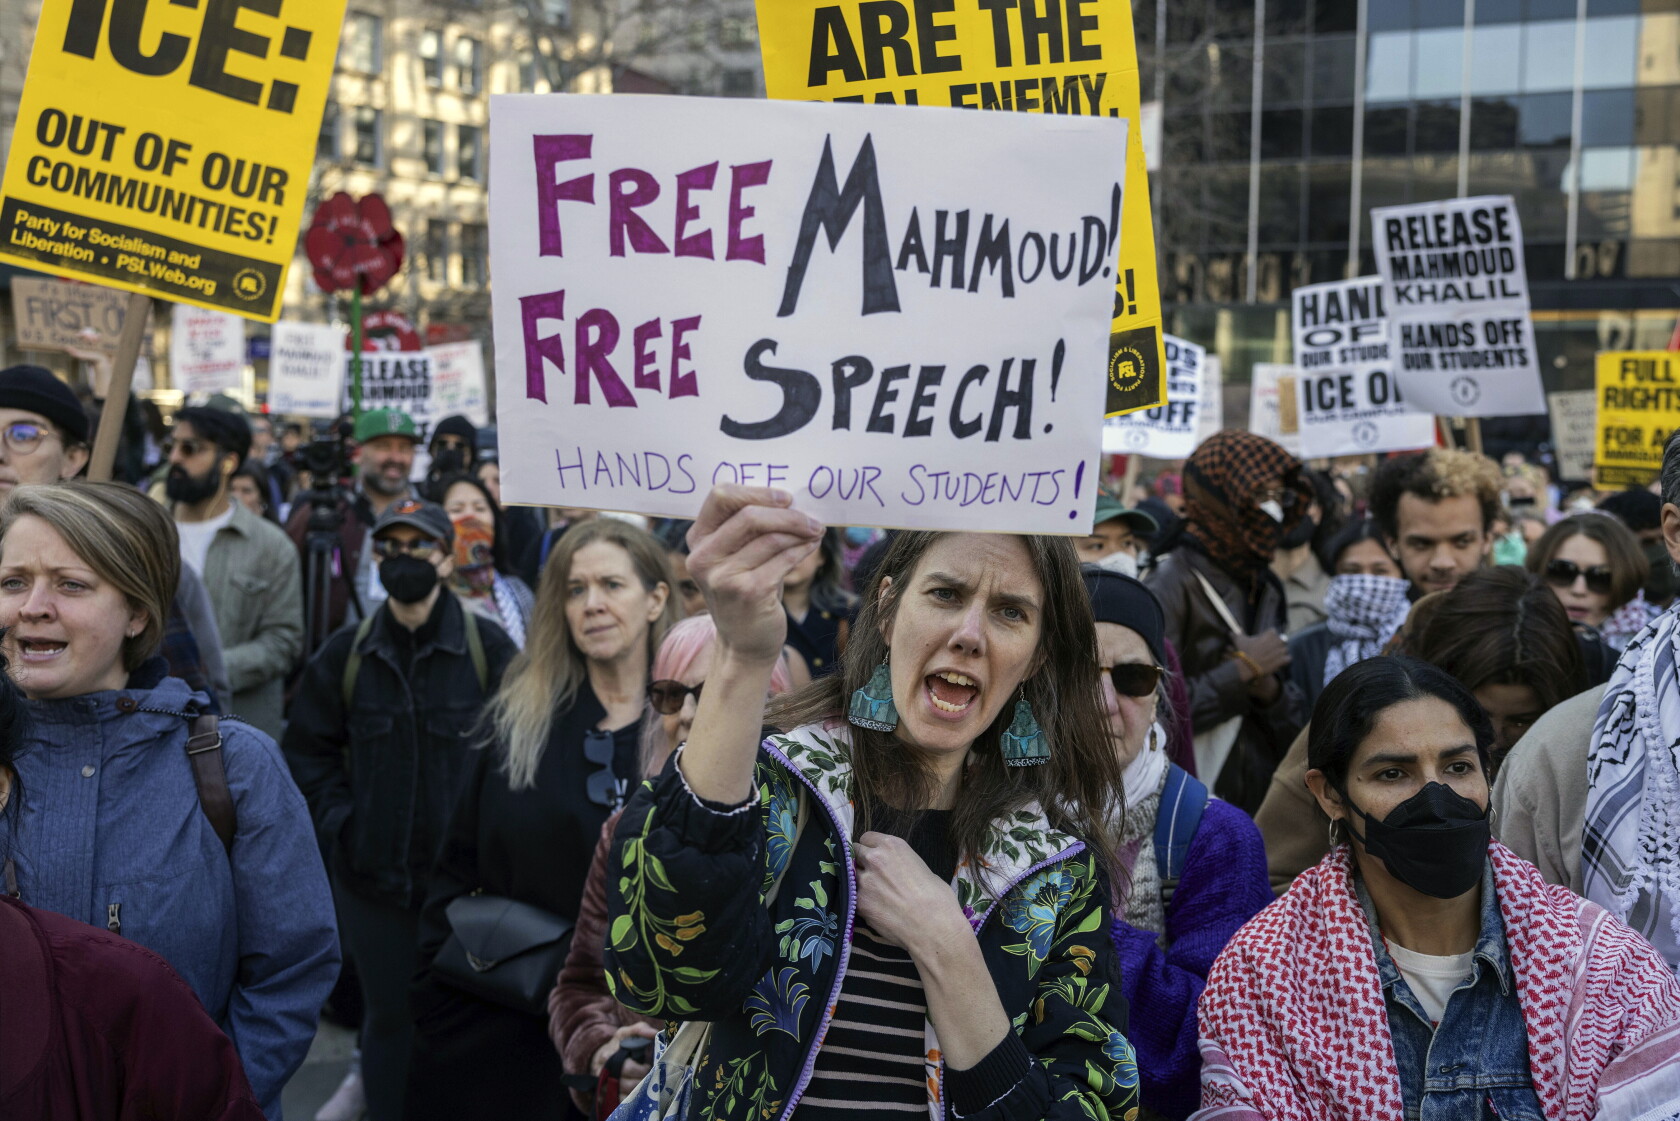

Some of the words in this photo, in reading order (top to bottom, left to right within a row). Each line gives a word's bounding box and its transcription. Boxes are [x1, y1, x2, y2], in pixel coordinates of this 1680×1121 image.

[62, 0, 313, 115] ICE:
[807, 0, 963, 88] ARE
[977, 0, 1103, 69] THE
[36, 107, 126, 162] OUT
[133, 131, 193, 177] OF
[201, 151, 289, 206] OUR
[26, 155, 279, 245] COMMUNITIES!
[14, 208, 61, 237] Party
[62, 221, 88, 241] for
[88, 227, 167, 261] Socialism
[167, 251, 202, 271] and
[533, 133, 774, 266] FREE
[777, 132, 1123, 318] MAHMOUD!
[1385, 206, 1512, 252] RELEASE
[10, 228, 95, 263] Liberation
[115, 253, 217, 297] PSLWeb.org
[1389, 246, 1515, 282] MAHMOUD
[1394, 278, 1520, 304] KHALIL
[102, 303, 126, 337] O
[1401, 322, 1476, 349] HANDS
[1484, 319, 1523, 345] OFF
[519, 289, 703, 409] FREE
[720, 338, 1067, 442] SPEECH!
[1117, 360, 1137, 379] PSL
[1302, 351, 1332, 368] OUR
[1402, 351, 1435, 371] OUR
[1438, 348, 1529, 371] STUDENTS
[1620, 358, 1676, 383] FULL
[1304, 375, 1355, 412] ICE
[1603, 426, 1643, 446] FOR
[556, 446, 696, 494] HANDS
[808, 465, 885, 508] OUR
[901, 460, 1086, 520] STUDENTS!
